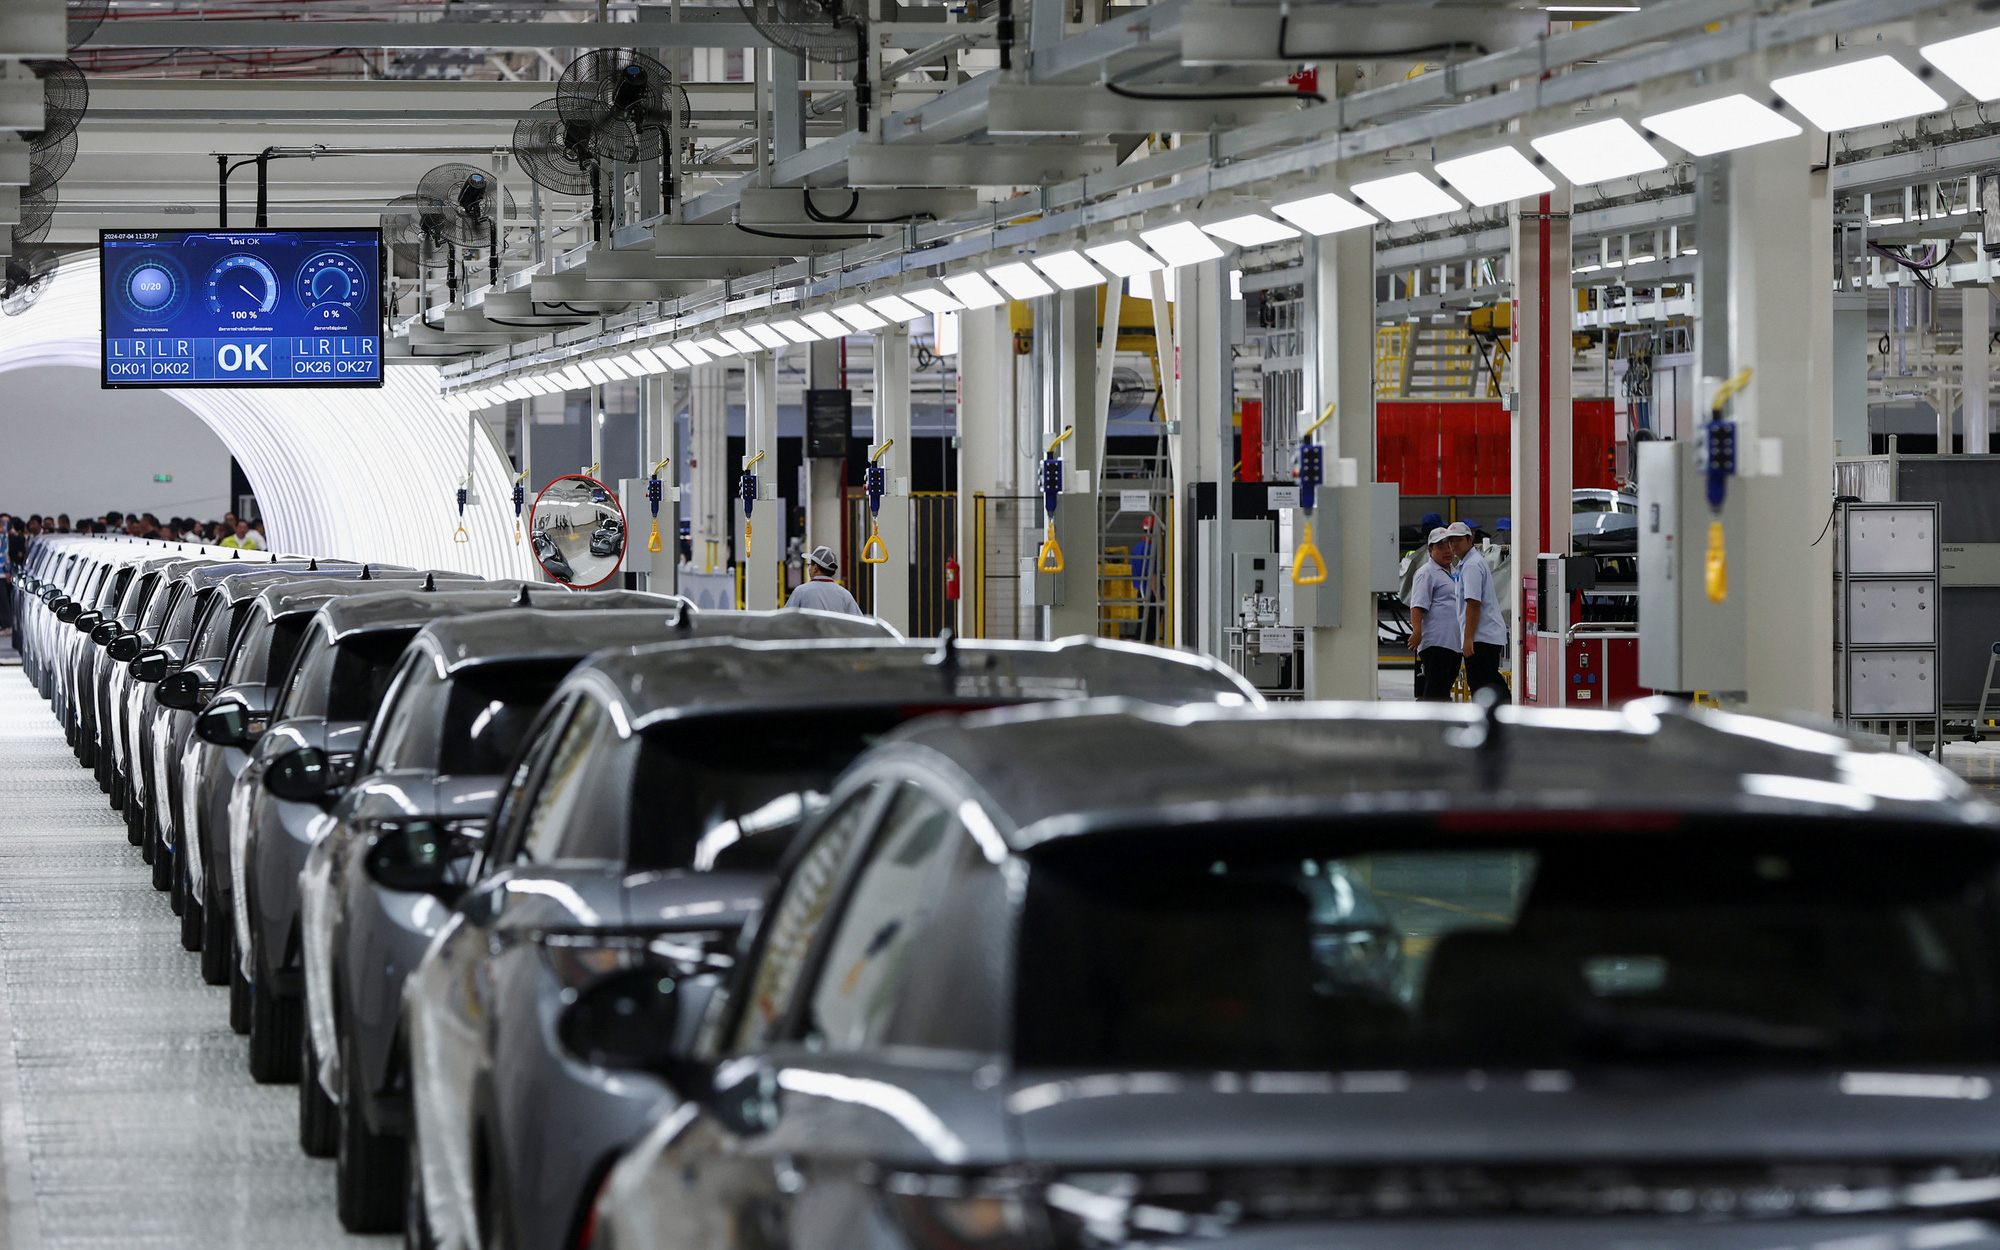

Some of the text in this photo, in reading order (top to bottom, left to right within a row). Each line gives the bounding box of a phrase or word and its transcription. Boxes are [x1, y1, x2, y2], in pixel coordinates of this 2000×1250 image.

[140, 282, 161, 291] 0/20
[114, 341, 123, 356] L
[135, 341, 146, 356] R
[158, 341, 167, 355] L
[178, 340, 188, 355] R
[300, 339, 308, 354] L
[320, 339, 330, 354] R
[342, 339, 350, 354] L
[362, 339, 372, 354] R
[218, 344, 268, 371] OK
[110, 363, 146, 375] OK01
[152, 363, 189, 374] OK02
[295, 361, 331, 373] OK26
[337, 361, 372, 373] OK27
